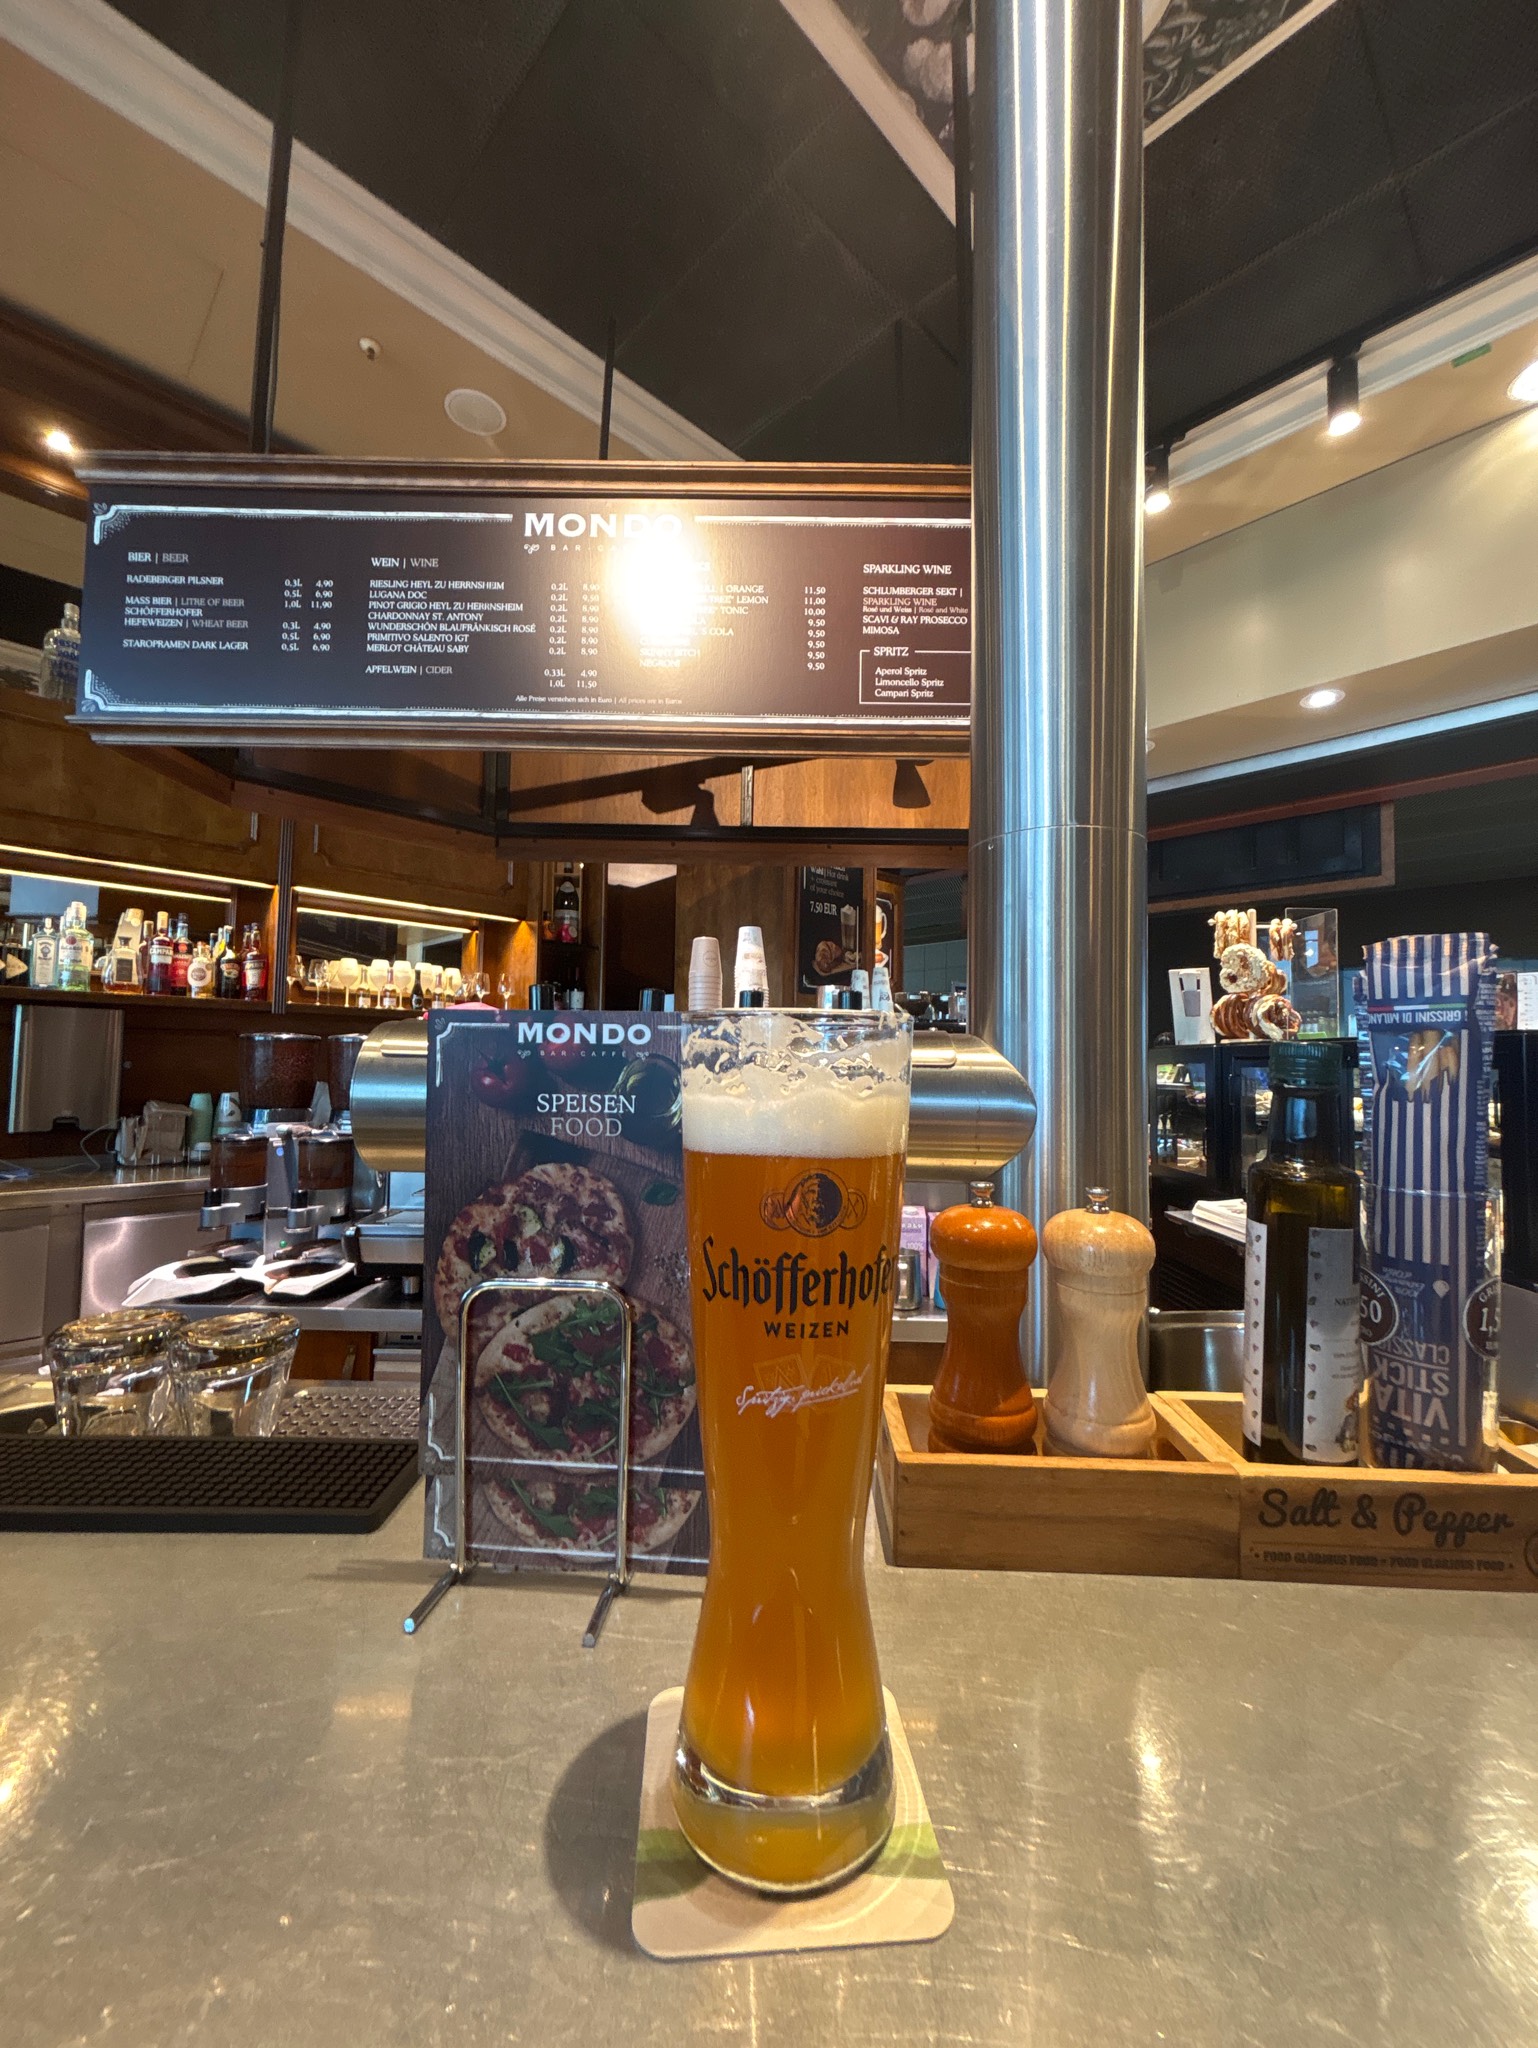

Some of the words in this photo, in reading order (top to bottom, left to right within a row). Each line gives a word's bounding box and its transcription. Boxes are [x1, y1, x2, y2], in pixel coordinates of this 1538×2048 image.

[524, 513, 683, 538] MONDO
[128, 552, 151, 562] BIER
[162, 553, 189, 563] BEER
[371, 558, 400, 567] WEIN
[410, 558, 439, 568] WINE
[863, 564, 920, 574] SPARKLING
[923, 565, 952, 575] WINE
[126, 575, 186, 585] RADEBERGER
[187, 576, 224, 585] PILSNER
[370, 580, 409, 589] RIESLING
[411, 580, 433, 589] HEYL
[434, 580, 446, 589] ZU
[369, 590, 405, 599] LUGANA
[408, 591, 428, 599] DOC
[726, 585, 764, 594] ORANGE
[863, 587, 934, 596] SCHLUMBERGER
[936, 588, 957, 596] SEKT
[125, 596, 150, 604] MASS
[152, 597, 172, 606] BIER
[181, 598, 205, 606] LITRE
[207, 598, 220, 606] OF
[222, 599, 245, 607] BEER
[737, 596, 769, 604] LEMON
[863, 598, 913, 606] SPARKLING
[914, 598, 938, 606] WINE
[368, 601, 395, 610] PINOT
[397, 602, 428, 610] GRIGIO
[429, 602, 452, 610] HEYL
[453, 602, 465, 610] ZU
[467, 602, 524, 612] HERRNSHEIM
[720, 606, 749, 615] TONIC
[368, 612, 430, 620] CHARDONNAY
[447, 613, 484, 622] ANTONY
[863, 615, 889, 623] SCAVI
[891, 616, 899, 624] &
[900, 616, 918, 624] RAY
[920, 616, 968, 625] PROSECCO
[124, 618, 183, 627] HEFEWEIZEN
[192, 620, 224, 628] WHEAT
[226, 620, 248, 629] BEER
[710, 628, 734, 636] COLA
[863, 626, 900, 635] MIMOSA
[367, 633, 410, 642] PRIMITIVO
[413, 633, 453, 642] SALENTO
[455, 634, 469, 643] IGT
[123, 640, 190, 649] STAROPRAMEN
[192, 641, 217, 650] DARK
[219, 641, 249, 650] LAGER
[366, 644, 402, 652] MERLOT
[447, 644, 470, 654] SABY
[874, 646, 909, 657] SPRITZ
[365, 665, 417, 674] APFELWEIN
[426, 666, 453, 674] CIDER
[875, 667, 902, 676] Aperol
[904, 667, 928, 677] Spritz
[875, 678, 920, 686] Limoncello
[922, 678, 944, 687] Spritz
[875, 689, 909, 698] Campari
[911, 689, 934, 698] Spritz
[1402, 1012, 1412, 1024] DI
[1415, 1010, 1462, 1023] GRISSINI
[518, 1022, 652, 1045] MONDO
[536, 1094, 636, 1114] SPEISEN
[550, 1118, 623, 1137] FOOD
[764, 1320, 849, 1339] WEIZEN
[1373, 1354, 1450, 1396] STICK
[1374, 1380, 1450, 1431] VITA
[1258, 1487, 1341, 1528] Salt
[1352, 1493, 1378, 1530] &
[1393, 1492, 1514, 1548] Pepper
